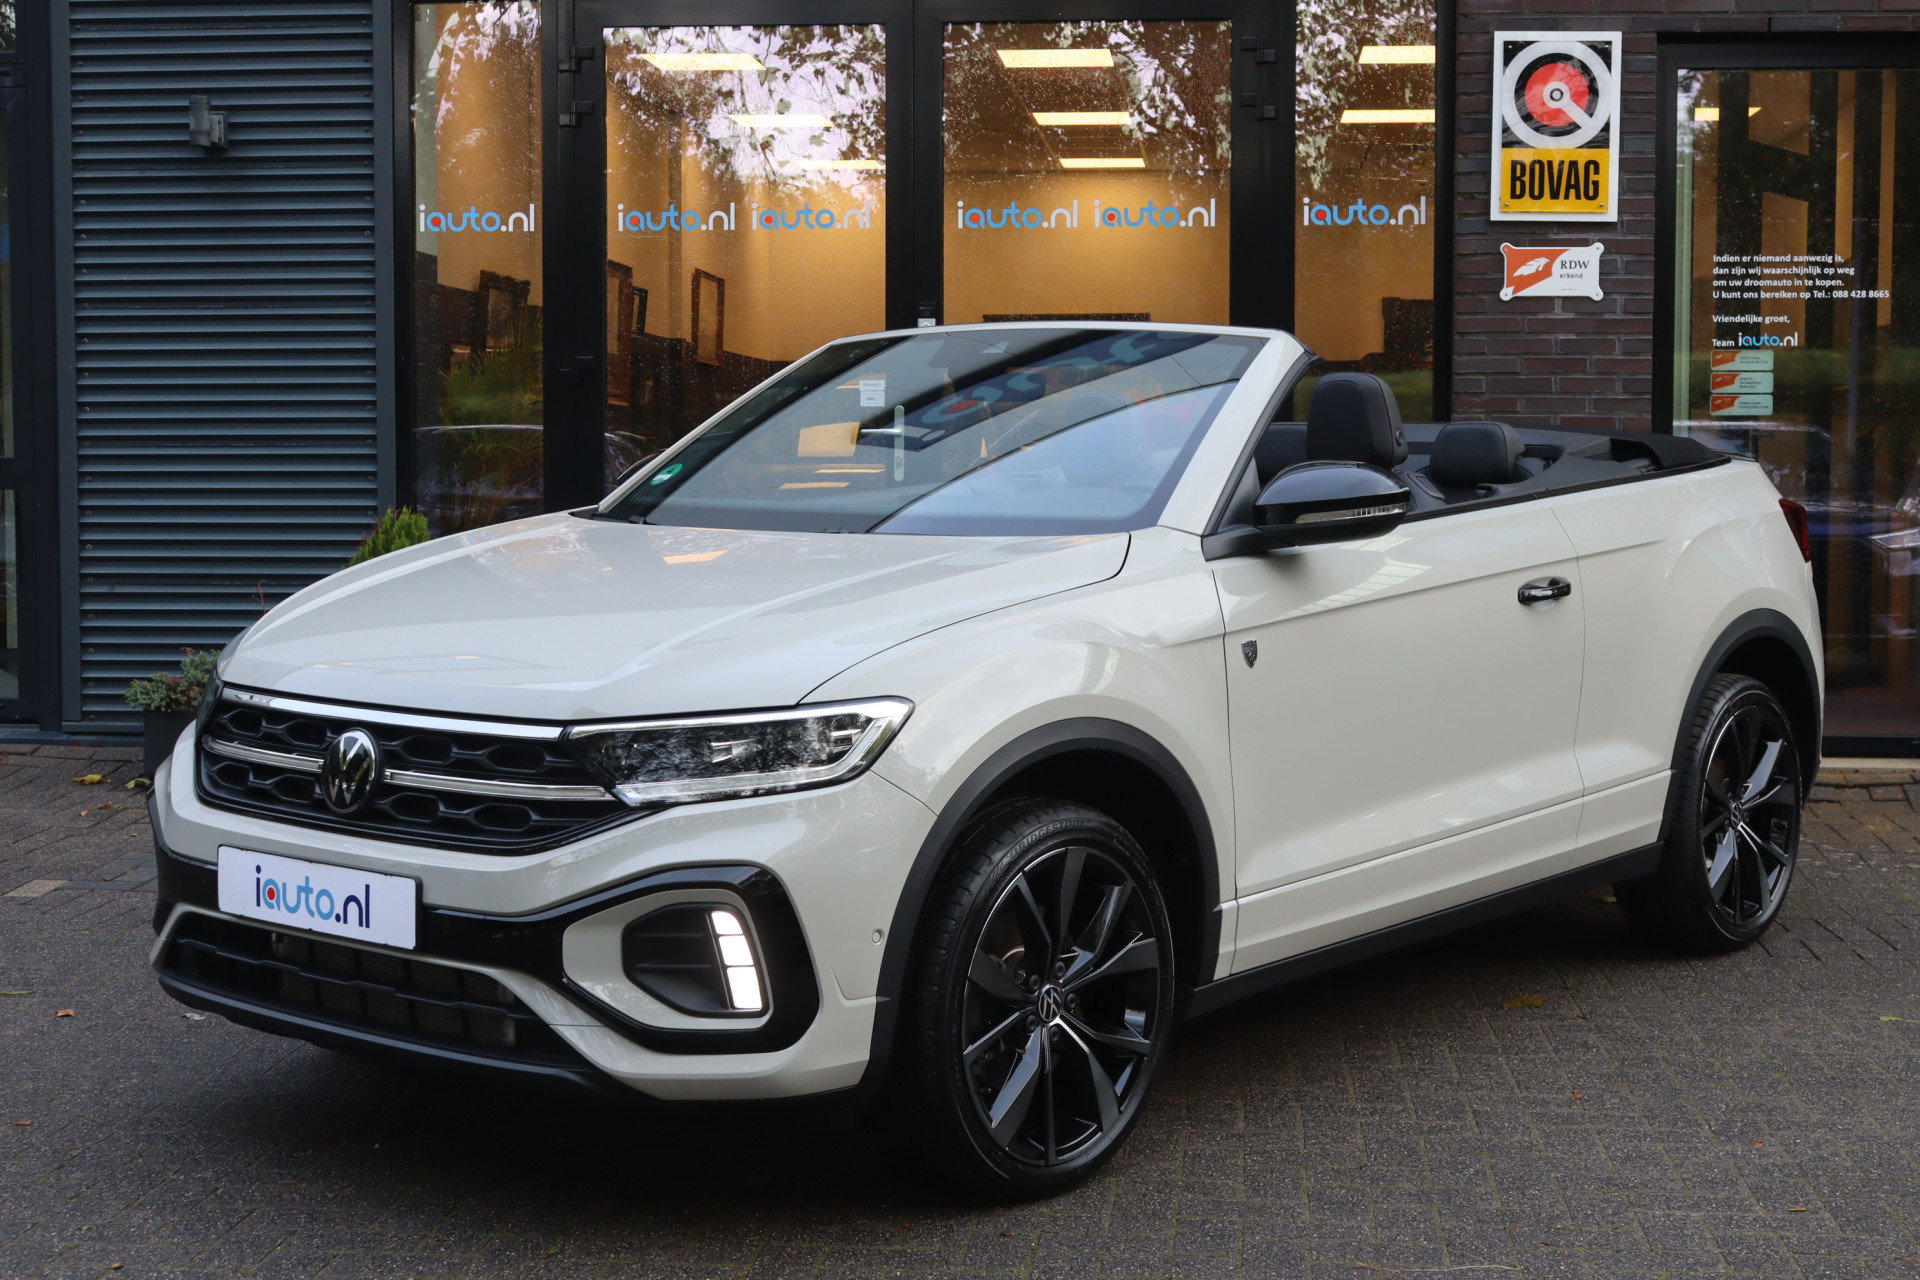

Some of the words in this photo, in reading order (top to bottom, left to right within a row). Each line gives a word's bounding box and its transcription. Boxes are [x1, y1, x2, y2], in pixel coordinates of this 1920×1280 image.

[1510, 159, 1600, 201] BOVAG
[419, 203, 535, 232] iauto.nl
[617, 202, 736, 231] iauto.nl
[751, 200, 871, 230] iauto.nl
[956, 199, 1078, 229] iauto.nl
[1094, 198, 1216, 228] iauto.nl
[1302, 195, 1426, 226] iauto.nl
[1560, 260, 1590, 270] RDW
[1713, 254, 1740, 263] Indien
[1753, 254, 1791, 263] niemand
[1793, 254, 1833, 264] aanwezig
[1835, 254, 1844, 264] is,
[1713, 266, 1730, 275] dan
[1731, 266, 1746, 276] zijn
[1748, 266, 1761, 276] wij
[1763, 266, 1822, 276] waarschijnlijk
[1824, 268, 1835, 276] op
[1837, 268, 1855, 276] weg
[1713, 291, 1720, 299] U
[1721, 290, 1741, 299] kunt
[1760, 290, 1798, 299] bereiken
[1800, 292, 1811, 300] op
[1812, 290, 1830, 298] Tel.:
[1832, 290, 1848, 298] 088
[1850, 290, 1867, 298] 428
[1868, 290, 1890, 298] 8665
[1744, 278, 1792, 287] droomauto
[1794, 278, 1802, 287] in
[1804, 279, 1813, 287] te
[1815, 278, 1844, 288] kopen.
[1712, 315, 1763, 324] Vriendelijke
[1764, 316, 1791, 324] groet,
[1712, 339, 1735, 347] Team
[1738, 332, 1798, 347] iauto.nl
[255, 864, 370, 929] iauto.nl
